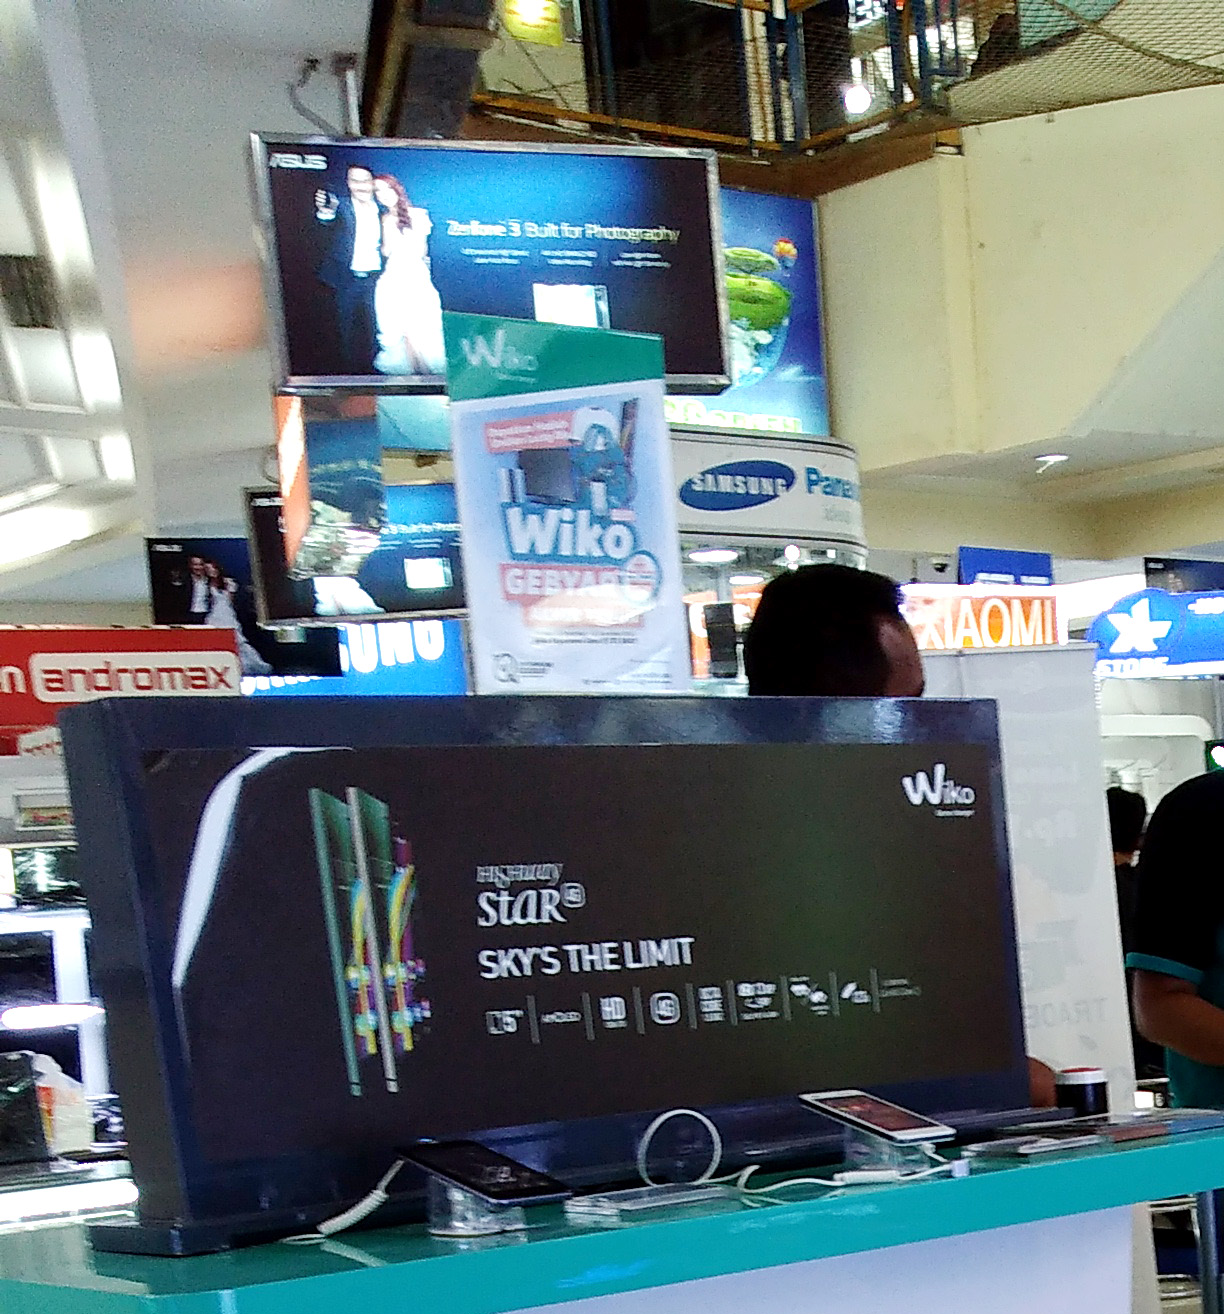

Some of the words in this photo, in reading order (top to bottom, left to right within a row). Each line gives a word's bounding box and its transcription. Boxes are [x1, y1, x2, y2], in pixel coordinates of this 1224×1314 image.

[269, 153, 327, 169] ASUS
[508, 219, 522, 237] 3
[585, 223, 680, 243] Photography
[691, 473, 787, 496] SAMSUNG
[506, 507, 634, 558] Wiko
[41, 660, 233, 692] andromax
[901, 763, 976, 806] Wiko
[477, 945, 562, 980] SKY'S
[561, 941, 622, 973] THE
[622, 935, 696, 969] LIMIT
